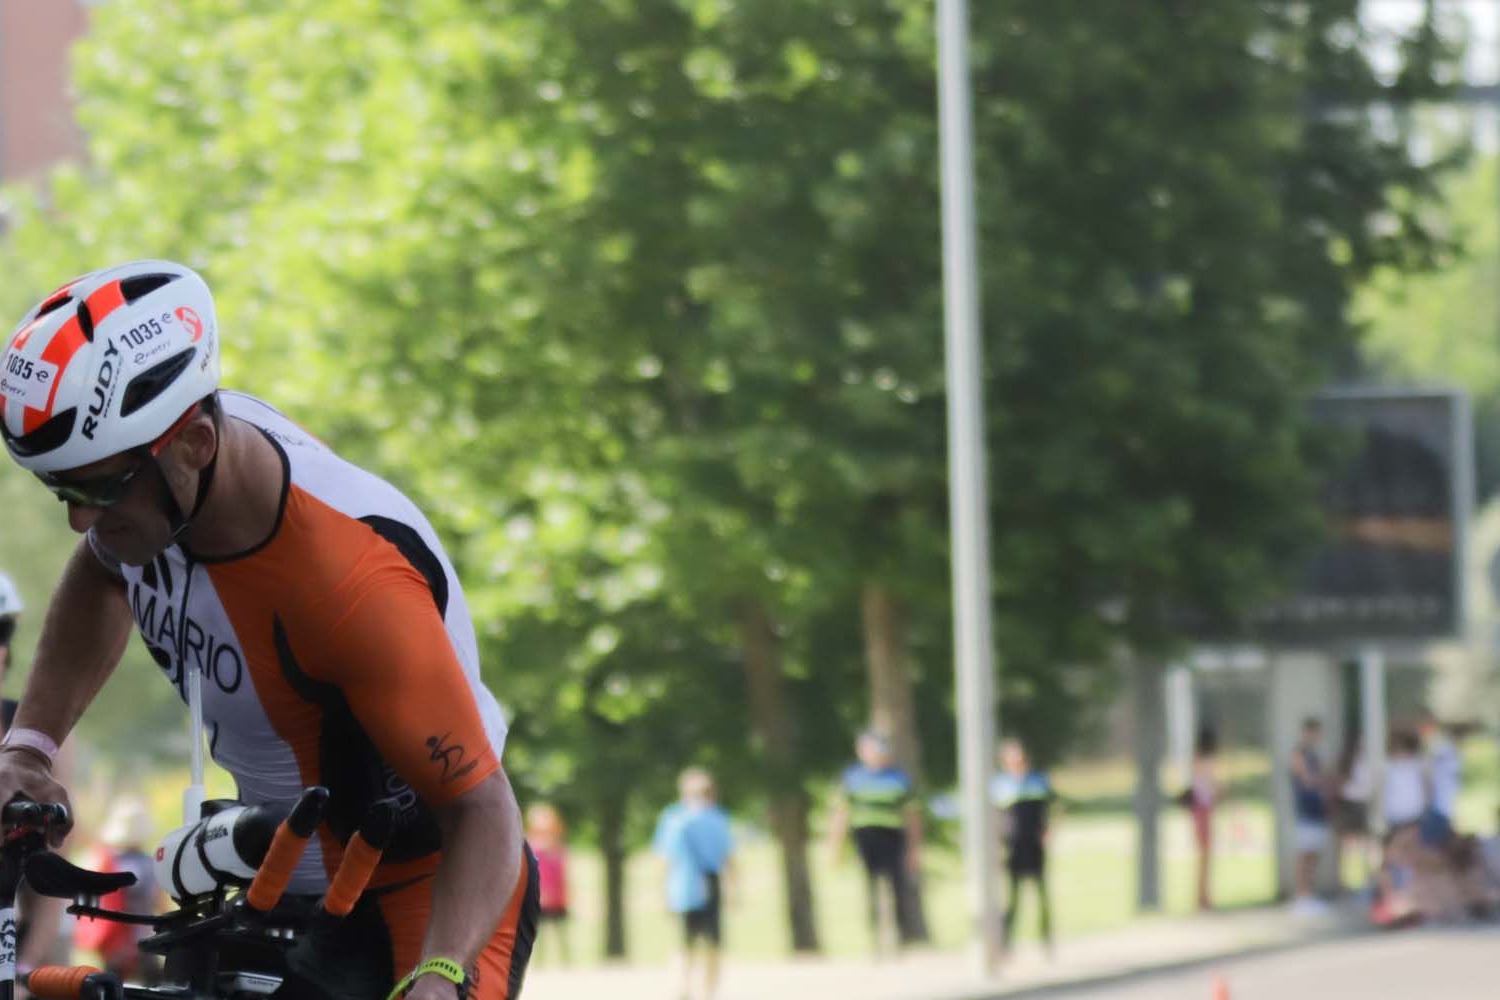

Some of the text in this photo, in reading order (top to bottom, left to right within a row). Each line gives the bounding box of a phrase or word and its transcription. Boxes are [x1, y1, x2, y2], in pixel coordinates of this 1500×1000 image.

[6, 353, 35, 380] 1035
[120, 317, 163, 350] 1035
[82, 337, 119, 440] RUDY
[133, 583, 242, 694] MARIO
